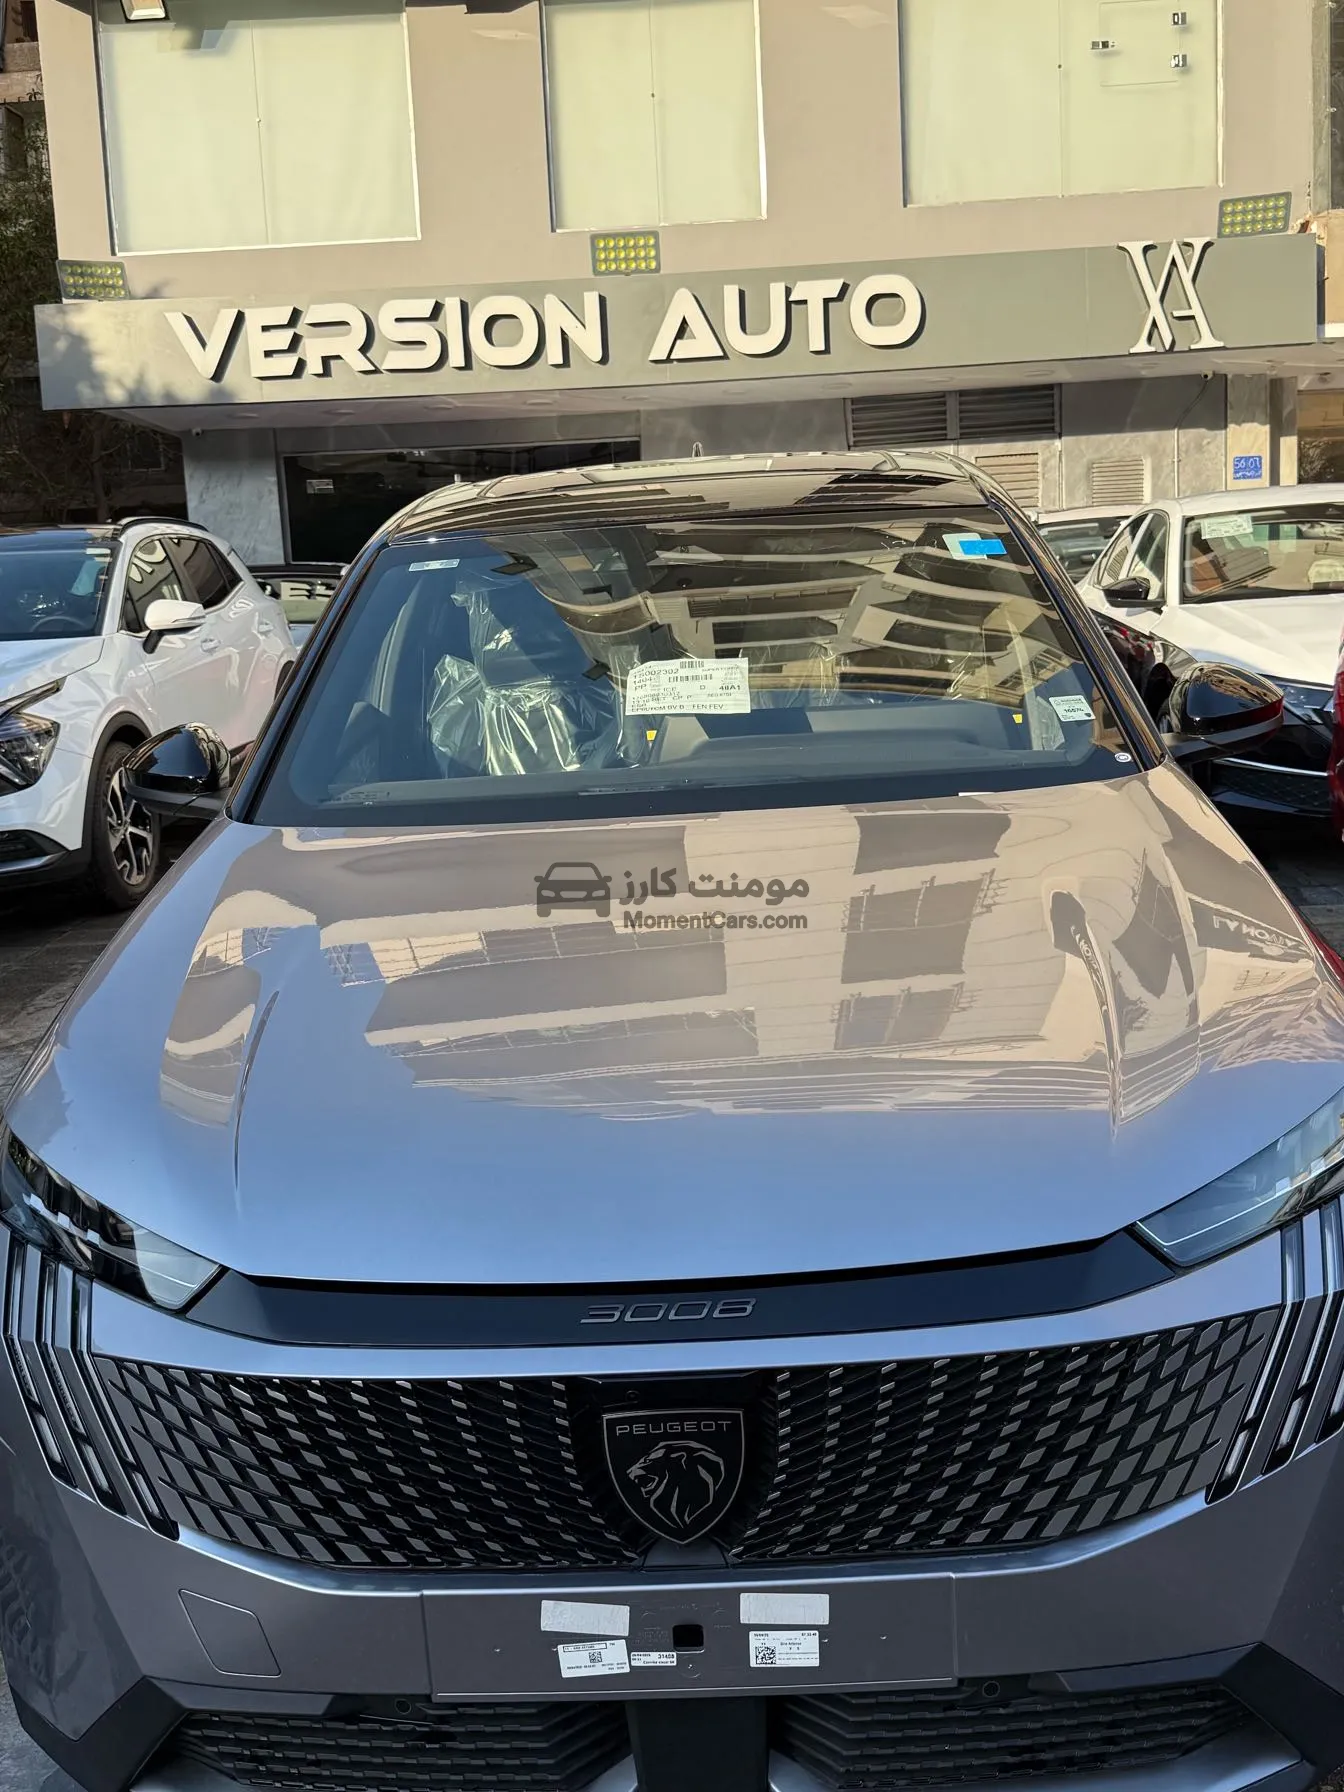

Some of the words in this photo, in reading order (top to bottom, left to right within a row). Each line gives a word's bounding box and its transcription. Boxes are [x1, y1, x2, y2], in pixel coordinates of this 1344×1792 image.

[165, 291, 609, 382] VERSION
[648, 273, 925, 362] AUTO
[580, 1297, 757, 1323] 3008
[615, 1420, 732, 1437] PEUGEOT
